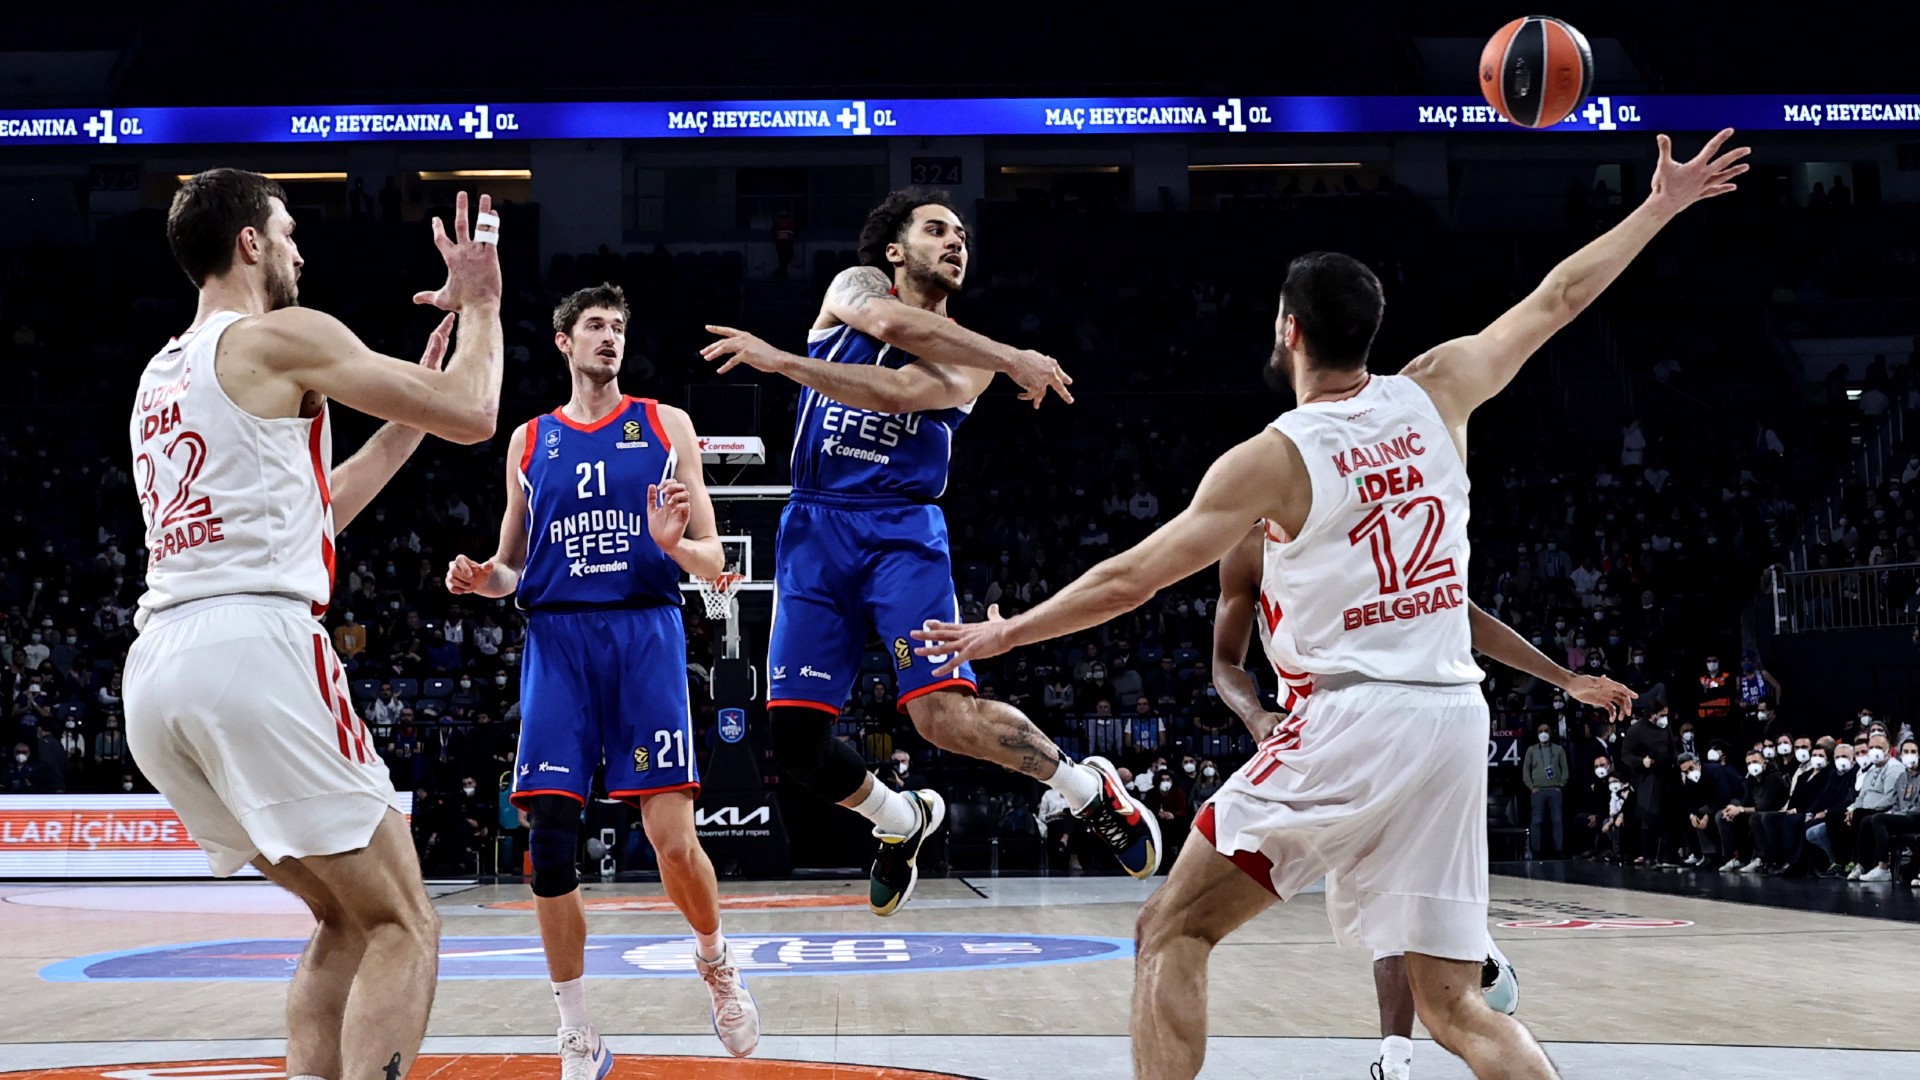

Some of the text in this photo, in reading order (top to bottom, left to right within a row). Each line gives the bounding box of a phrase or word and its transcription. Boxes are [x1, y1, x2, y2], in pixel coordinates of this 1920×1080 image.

[83, 110, 117, 143] +1
[120, 118, 143, 135] OL
[290, 105, 519, 139] MAÇ HEYECANINA +1 OL
[668, 101, 897, 136] MAÇ HEYECANINA +1 OL
[1045, 98, 1272, 132] MAÇ HEYECANINA +1 OL
[1418, 105, 1458, 128] MAÇ
[1582, 97, 1617, 130] +1
[1618, 105, 1641, 122] OL
[1783, 104, 1822, 126] MAÇ
[913, 164, 958, 183] 324
[822, 406, 901, 447] EFES
[708, 442, 745, 450] corendon
[835, 444, 890, 466] corendon
[575, 460, 606, 499] 21
[150, 518, 225, 568] GRADE
[551, 509, 641, 544] ANADOLU
[565, 532, 630, 558] EFES
[1348, 496, 1456, 595] 12
[583, 561, 628, 574] corendon
[654, 729, 686, 768] 21
[2, 813, 179, 851] LAR İÇİNDE
[695, 806, 771, 826] KIA
[731, 829, 744, 837] that
[745, 829, 771, 838] inspires
